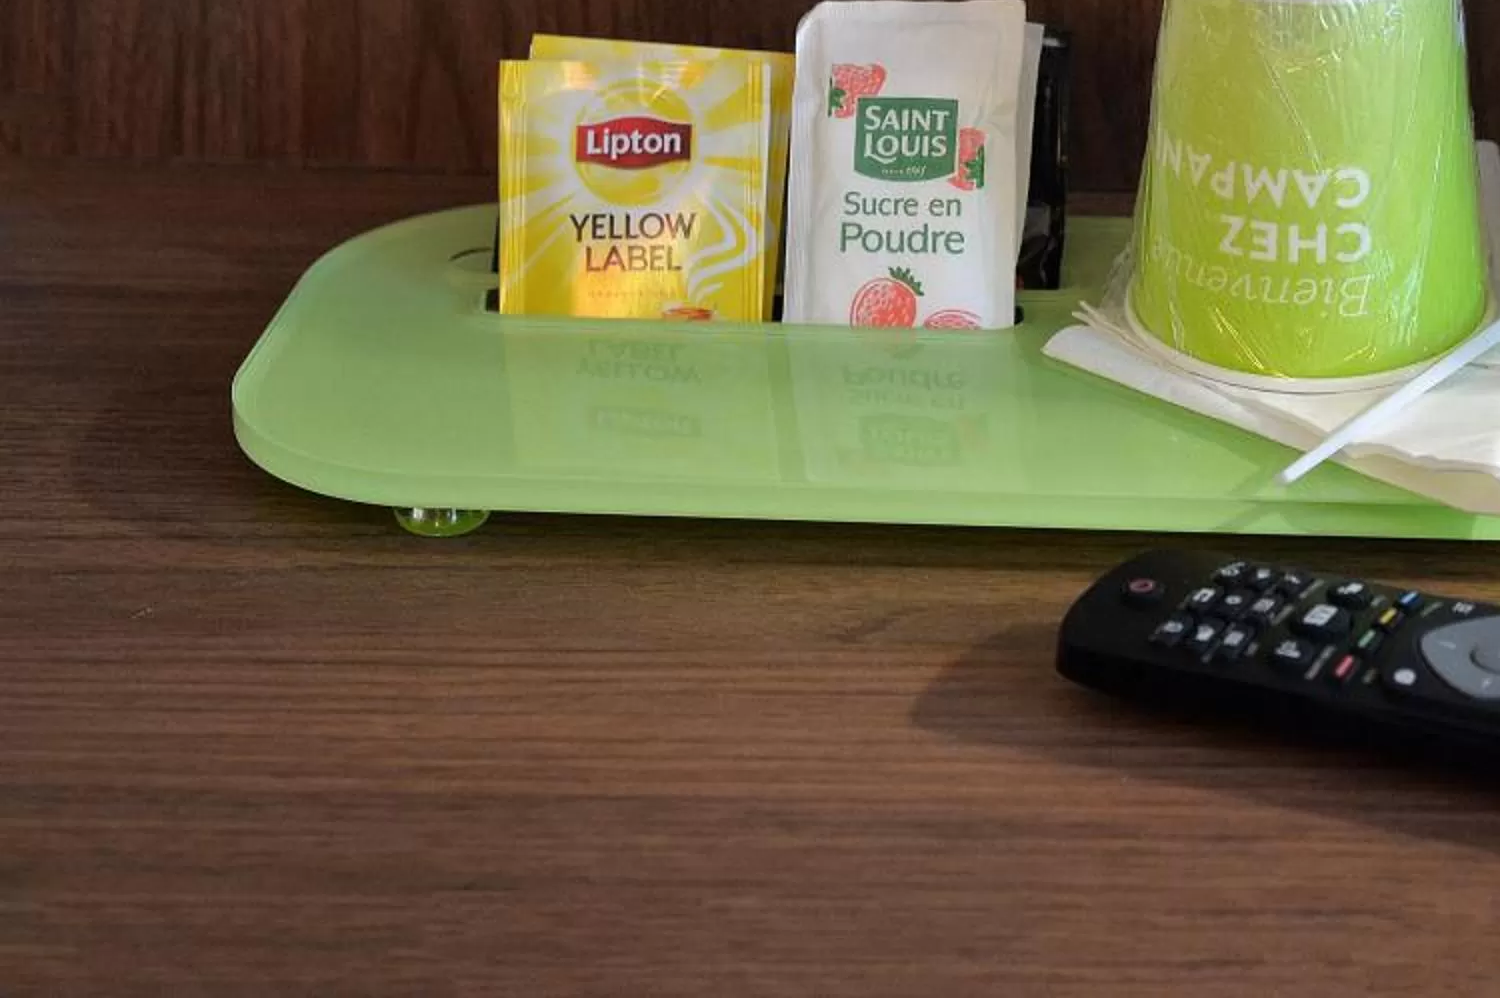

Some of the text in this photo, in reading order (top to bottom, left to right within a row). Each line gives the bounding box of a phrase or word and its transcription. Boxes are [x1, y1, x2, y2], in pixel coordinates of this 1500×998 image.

[863, 104, 950, 132] SAINT
[585, 127, 682, 161] Lipton
[863, 132, 948, 165] LOUIS
[843, 190, 963, 217] Sucre en
[569, 212, 697, 243] YELLOW
[839, 221, 966, 254] Poudre
[1219, 213, 1372, 266] CHEZ
[585, 245, 683, 273] LABEL
